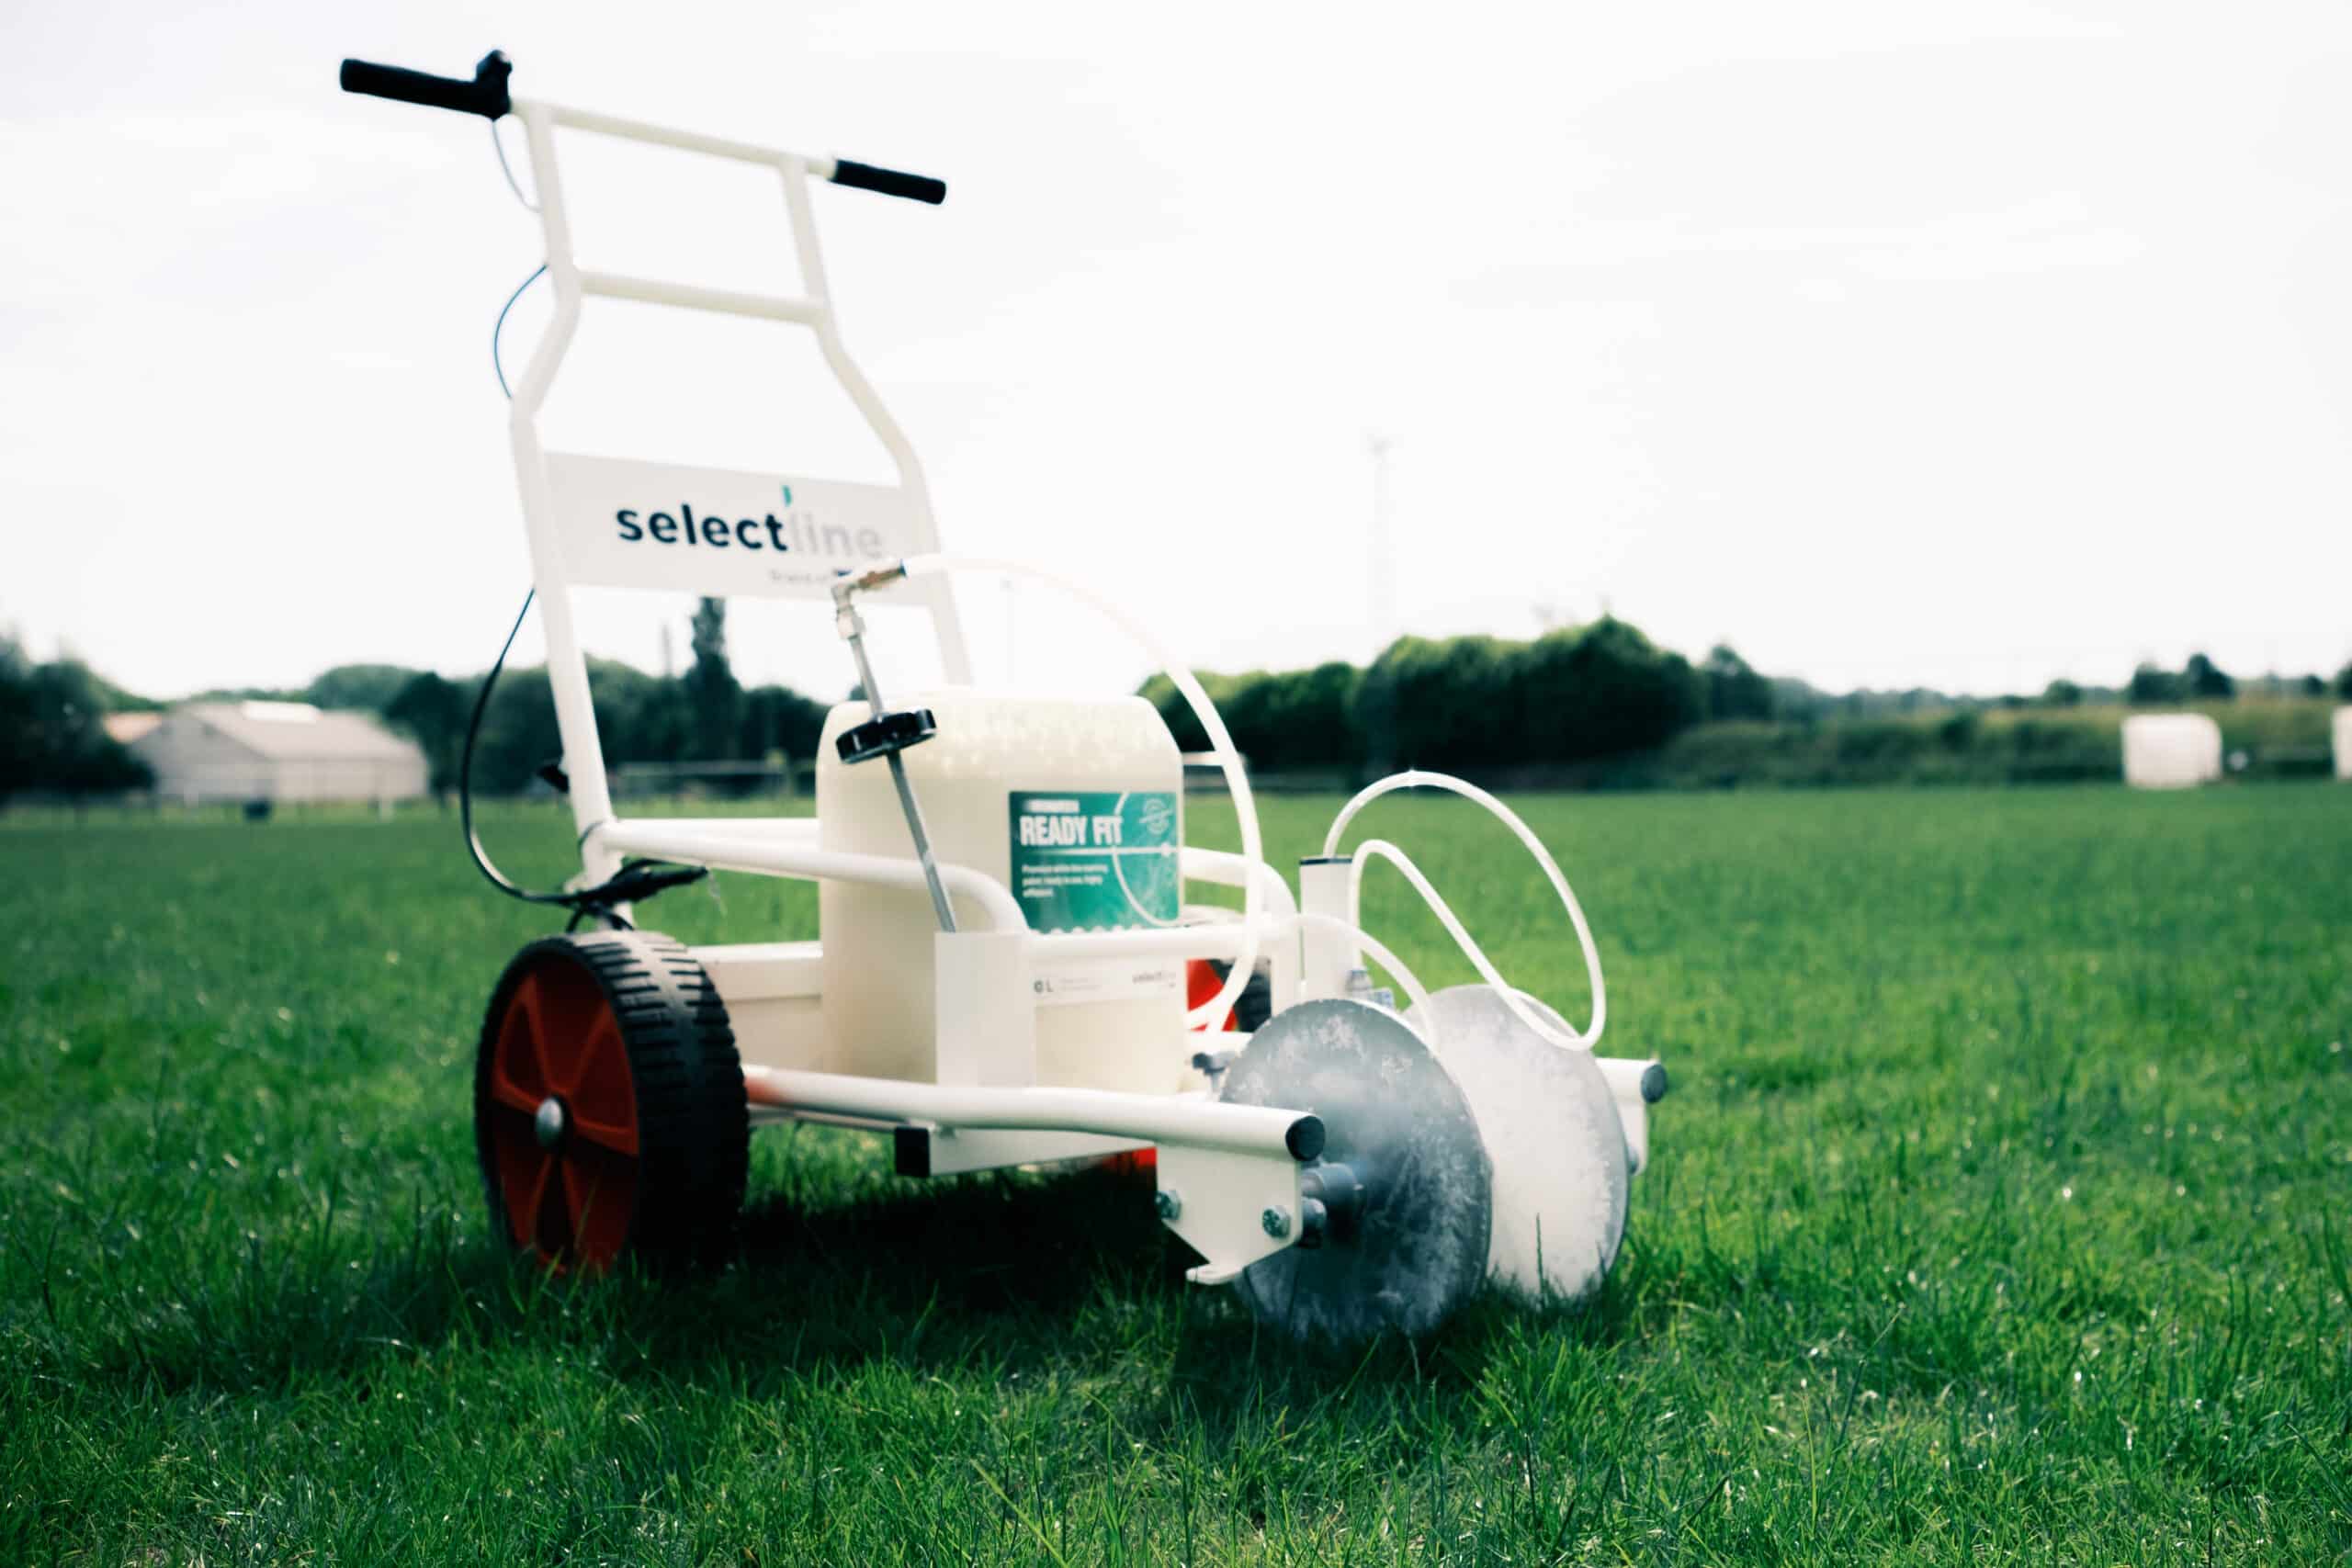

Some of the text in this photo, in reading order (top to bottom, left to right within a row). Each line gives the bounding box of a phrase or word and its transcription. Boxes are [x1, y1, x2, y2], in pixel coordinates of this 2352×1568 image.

[616, 485, 883, 559] selectline
[1020, 816, 1087, 845] READY
[1092, 816, 1123, 845] FIT
